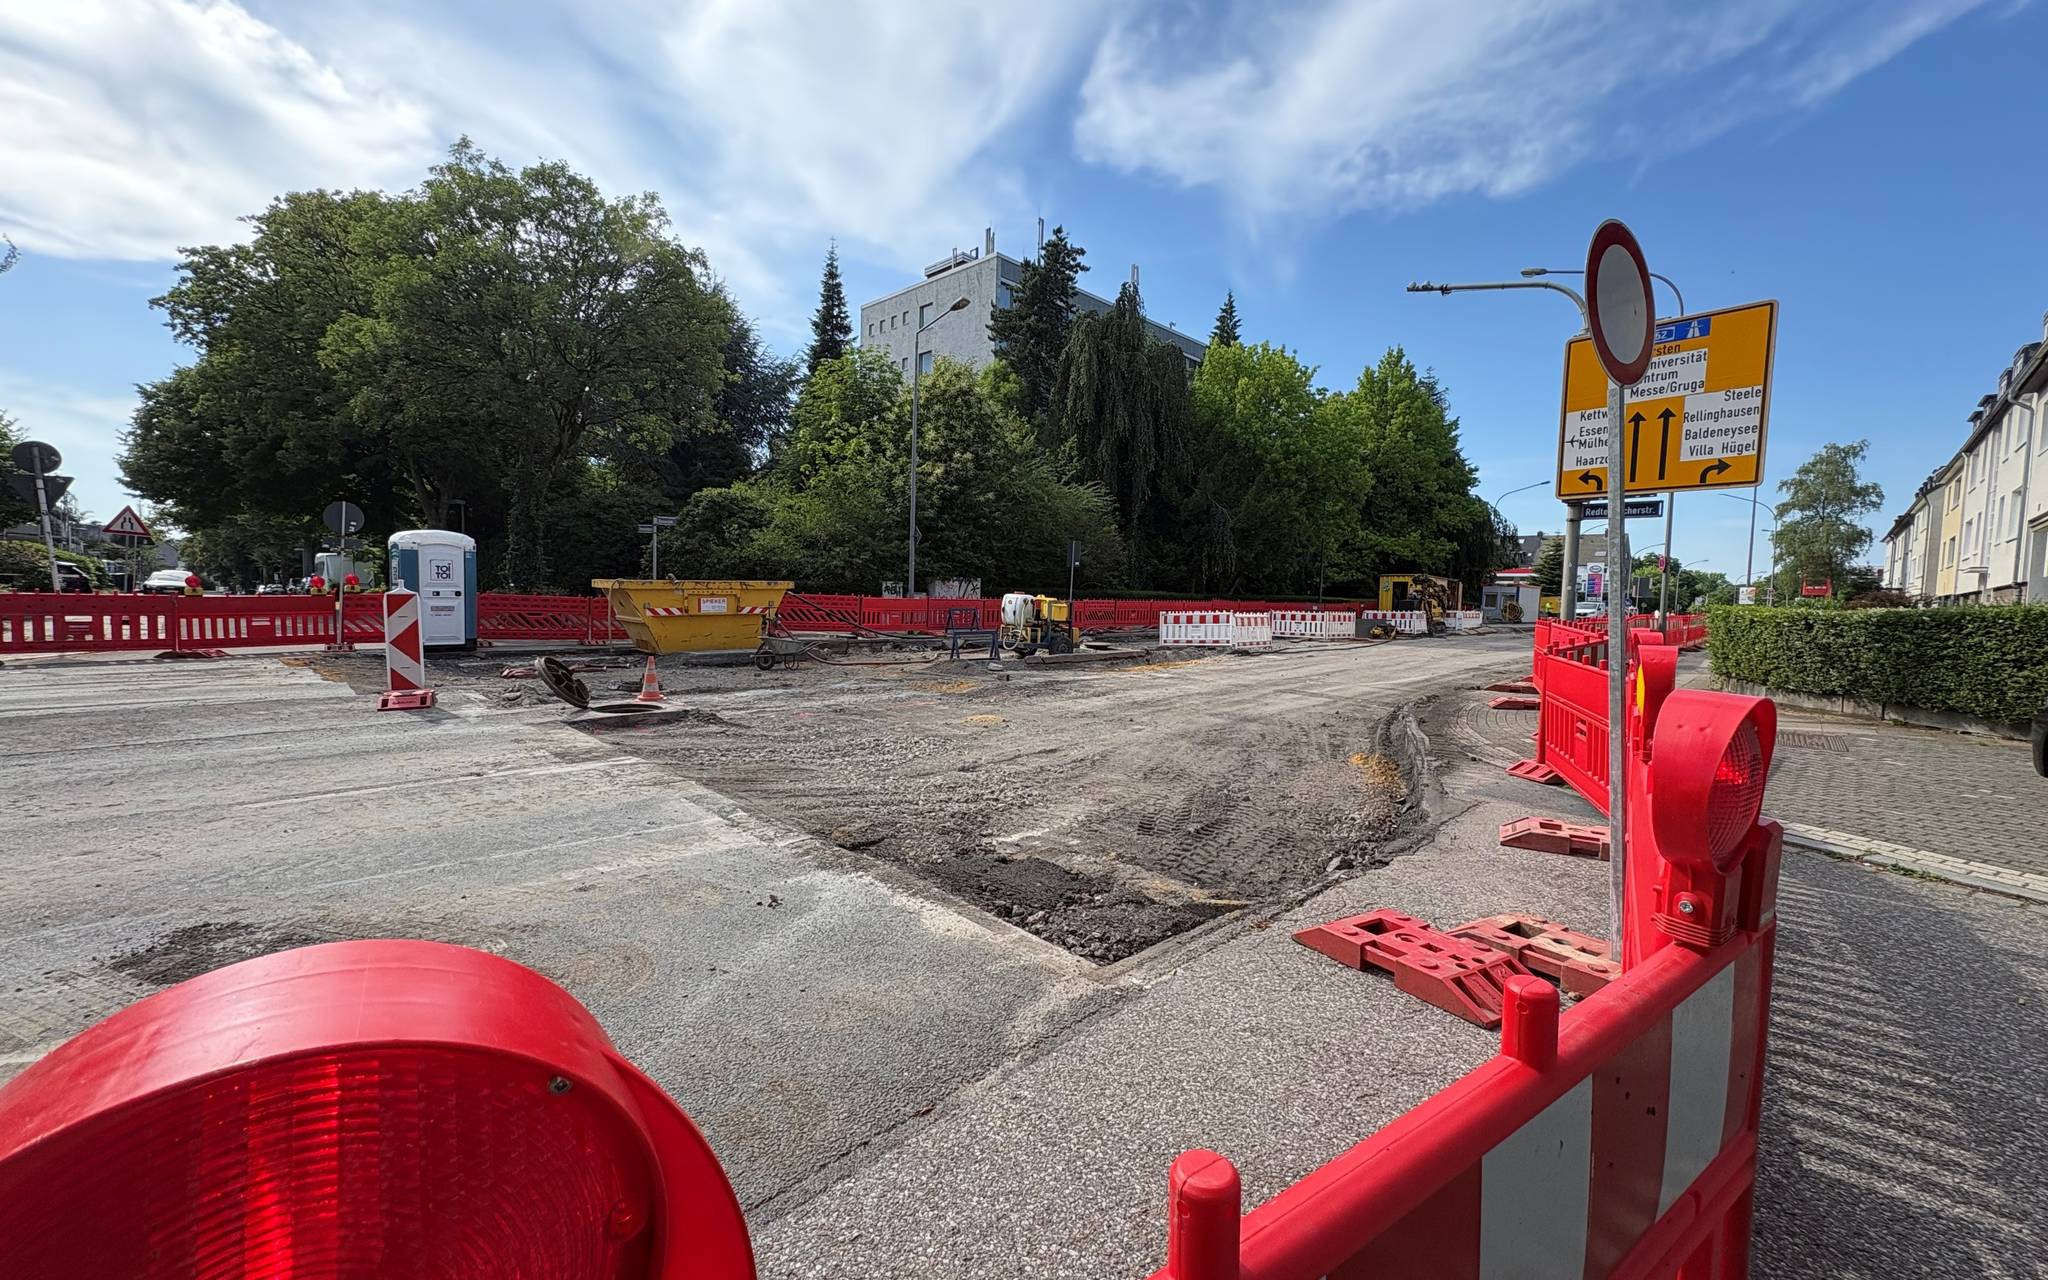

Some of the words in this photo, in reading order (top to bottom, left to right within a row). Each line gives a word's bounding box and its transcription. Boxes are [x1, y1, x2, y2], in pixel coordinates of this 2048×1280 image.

[1654, 344, 1681, 356] sten
[1650, 350, 1708, 370] niversität
[1642, 370, 1679, 384] ntrum
[1630, 380, 1705, 398] Messe/Gruga
[1724, 386, 1762, 401] Steele
[1580, 410, 1608, 422] Kettw
[1683, 406, 1760, 423] Rellinghausen
[1685, 424, 1758, 440] Baldeneysee
[1579, 437, 1608, 449] Mülhe
[1689, 444, 1714, 456] Villa
[1721, 440, 1756, 455] Hügel
[435, 572, 451, 580] TOI
